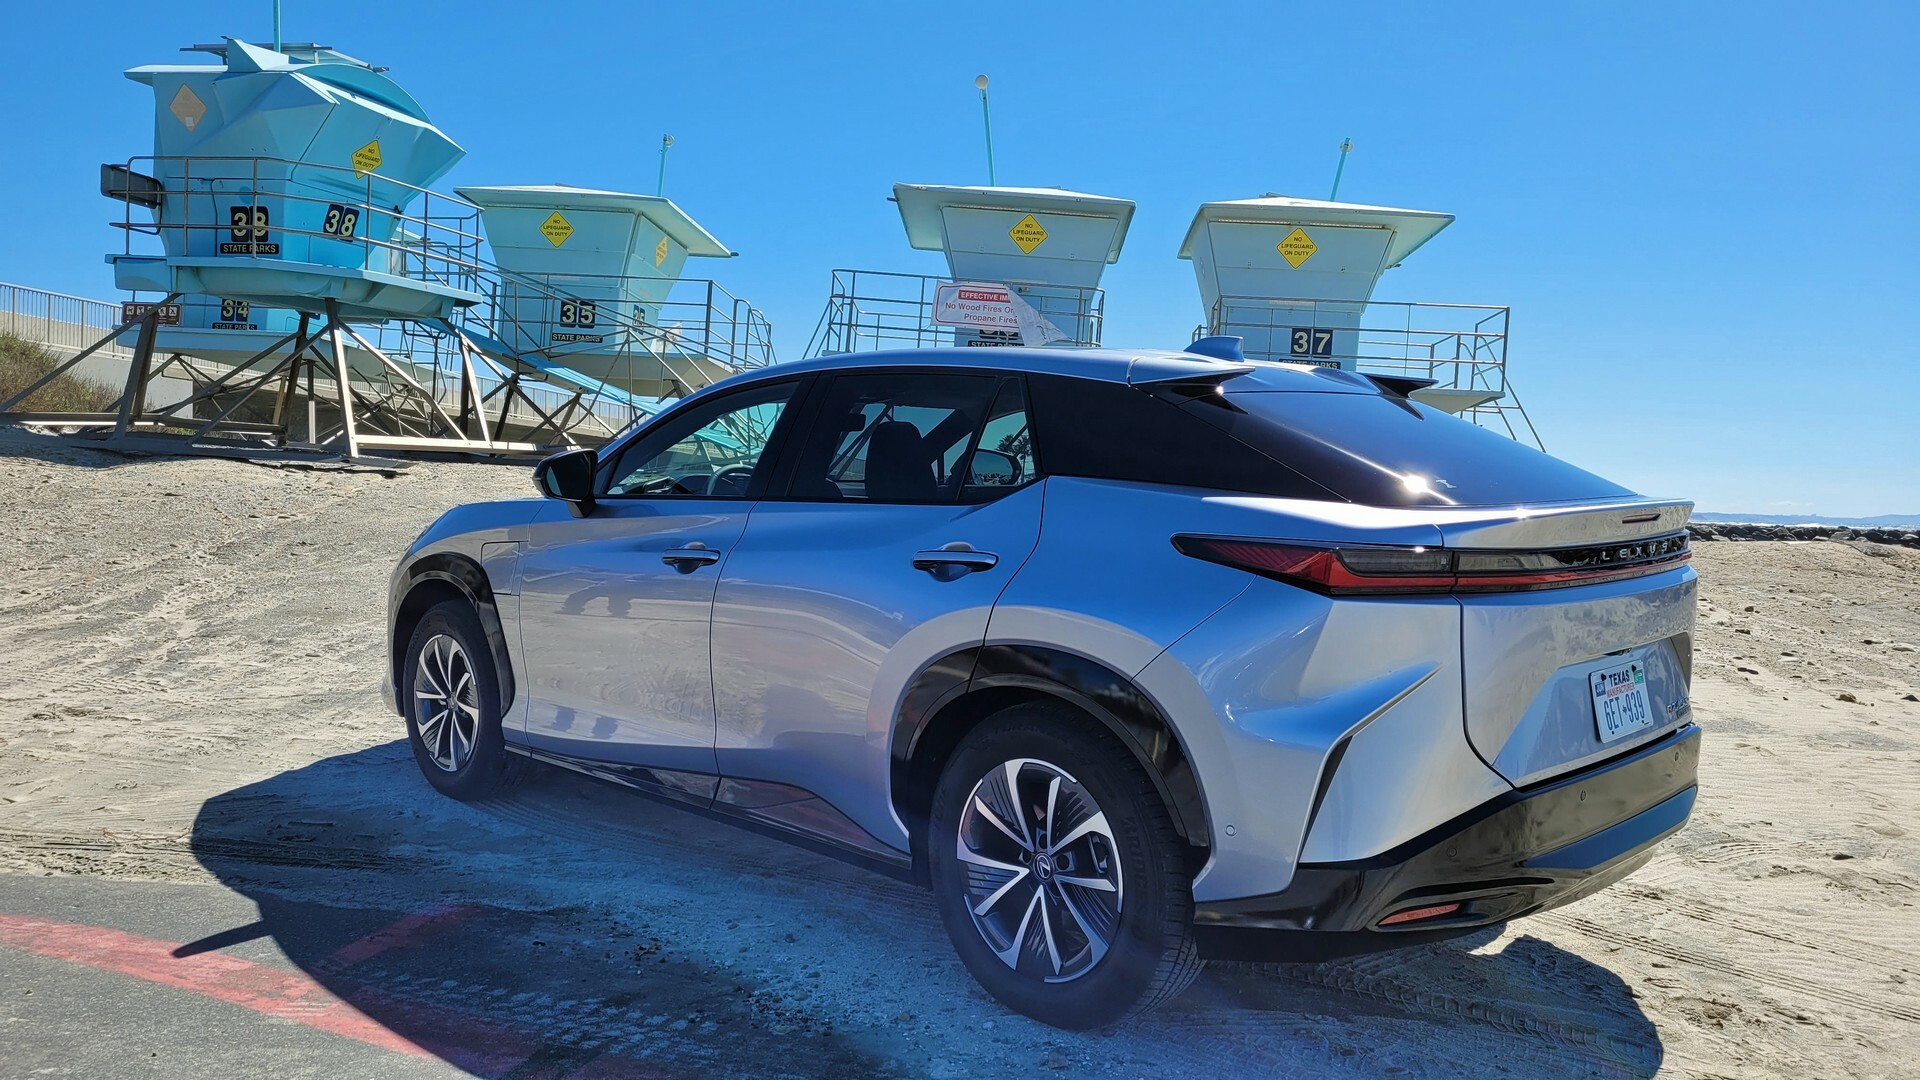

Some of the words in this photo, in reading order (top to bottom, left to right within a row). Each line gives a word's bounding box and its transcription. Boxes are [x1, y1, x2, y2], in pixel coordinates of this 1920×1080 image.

[355, 152, 380, 163] LIFEGUARD
[234, 212, 266, 236] 38
[325, 209, 356, 236] 38
[1012, 229, 1045, 237] LIFEGUARD
[223, 244, 247, 252] STATE
[960, 291, 998, 300] EFFECTIVE
[222, 299, 249, 318] 34
[562, 304, 593, 324] 35
[945, 302, 956, 310] No
[958, 303, 980, 311] Wood
[982, 304, 1002, 312] Fires
[964, 313, 996, 323] Propane
[998, 315, 1018, 324] Fires
[552, 333, 574, 341] STATE
[1293, 331, 1331, 353] 37
[1602, 542, 1668, 561] LEXUS
[1608, 669, 1630, 687] TEXAS
